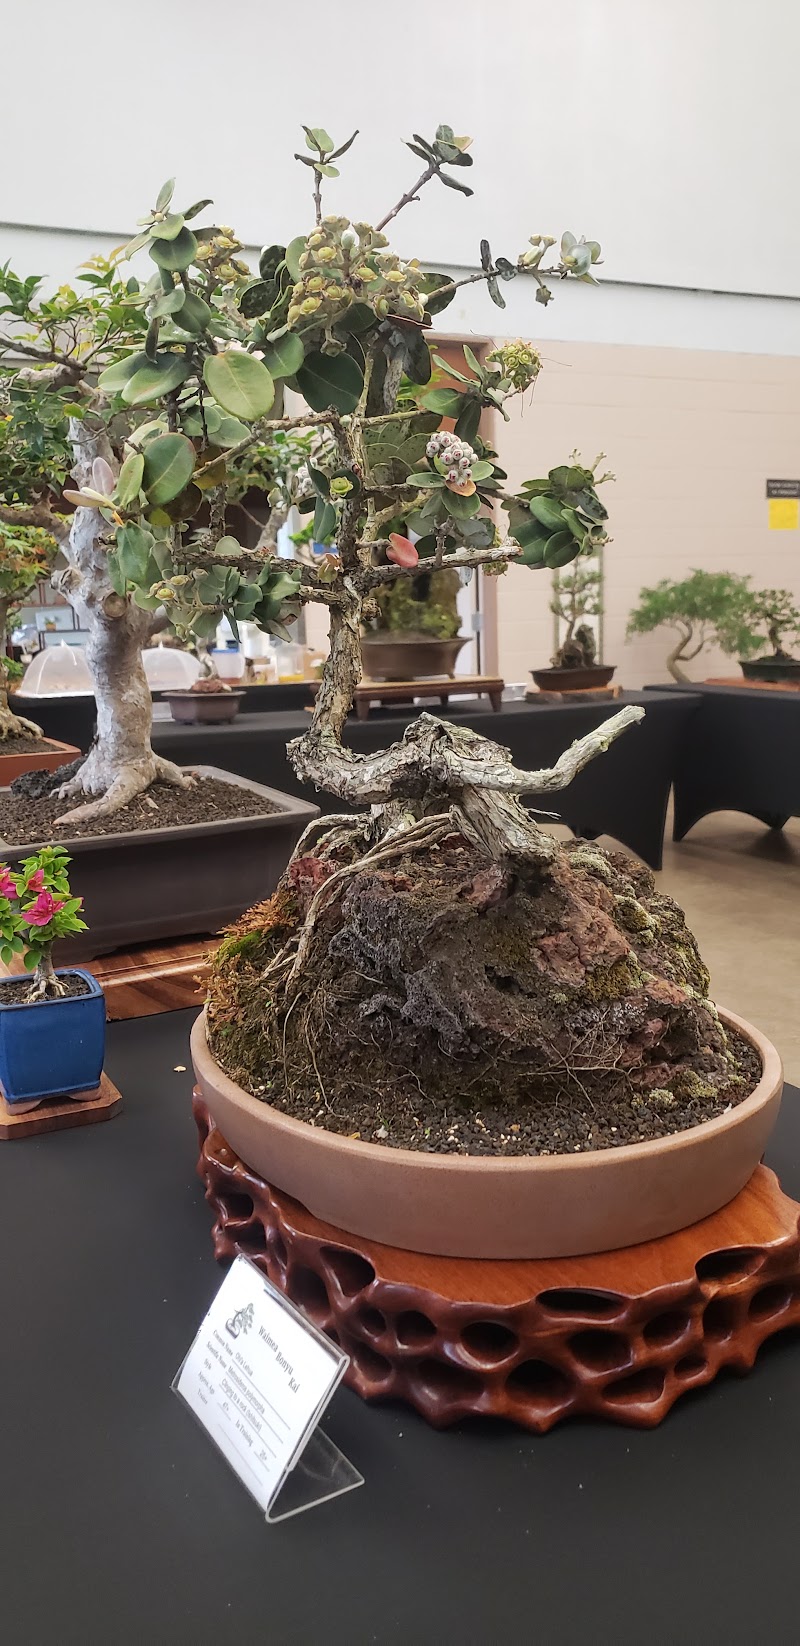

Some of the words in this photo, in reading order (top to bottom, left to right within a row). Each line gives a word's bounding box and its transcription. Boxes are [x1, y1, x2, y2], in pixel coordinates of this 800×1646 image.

[206, 1341, 219, 1359] Scientific
[218, 1355, 227, 1369] Name
[213, 1329, 225, 1347] Common
[225, 1343, 233, 1356] Name
[258, 1325, 279, 1353] Waimea
[275, 1351, 294, 1375] Bonyu
[288, 1377, 300, 1393] Kai
[239, 1424, 253, 1447] Training
